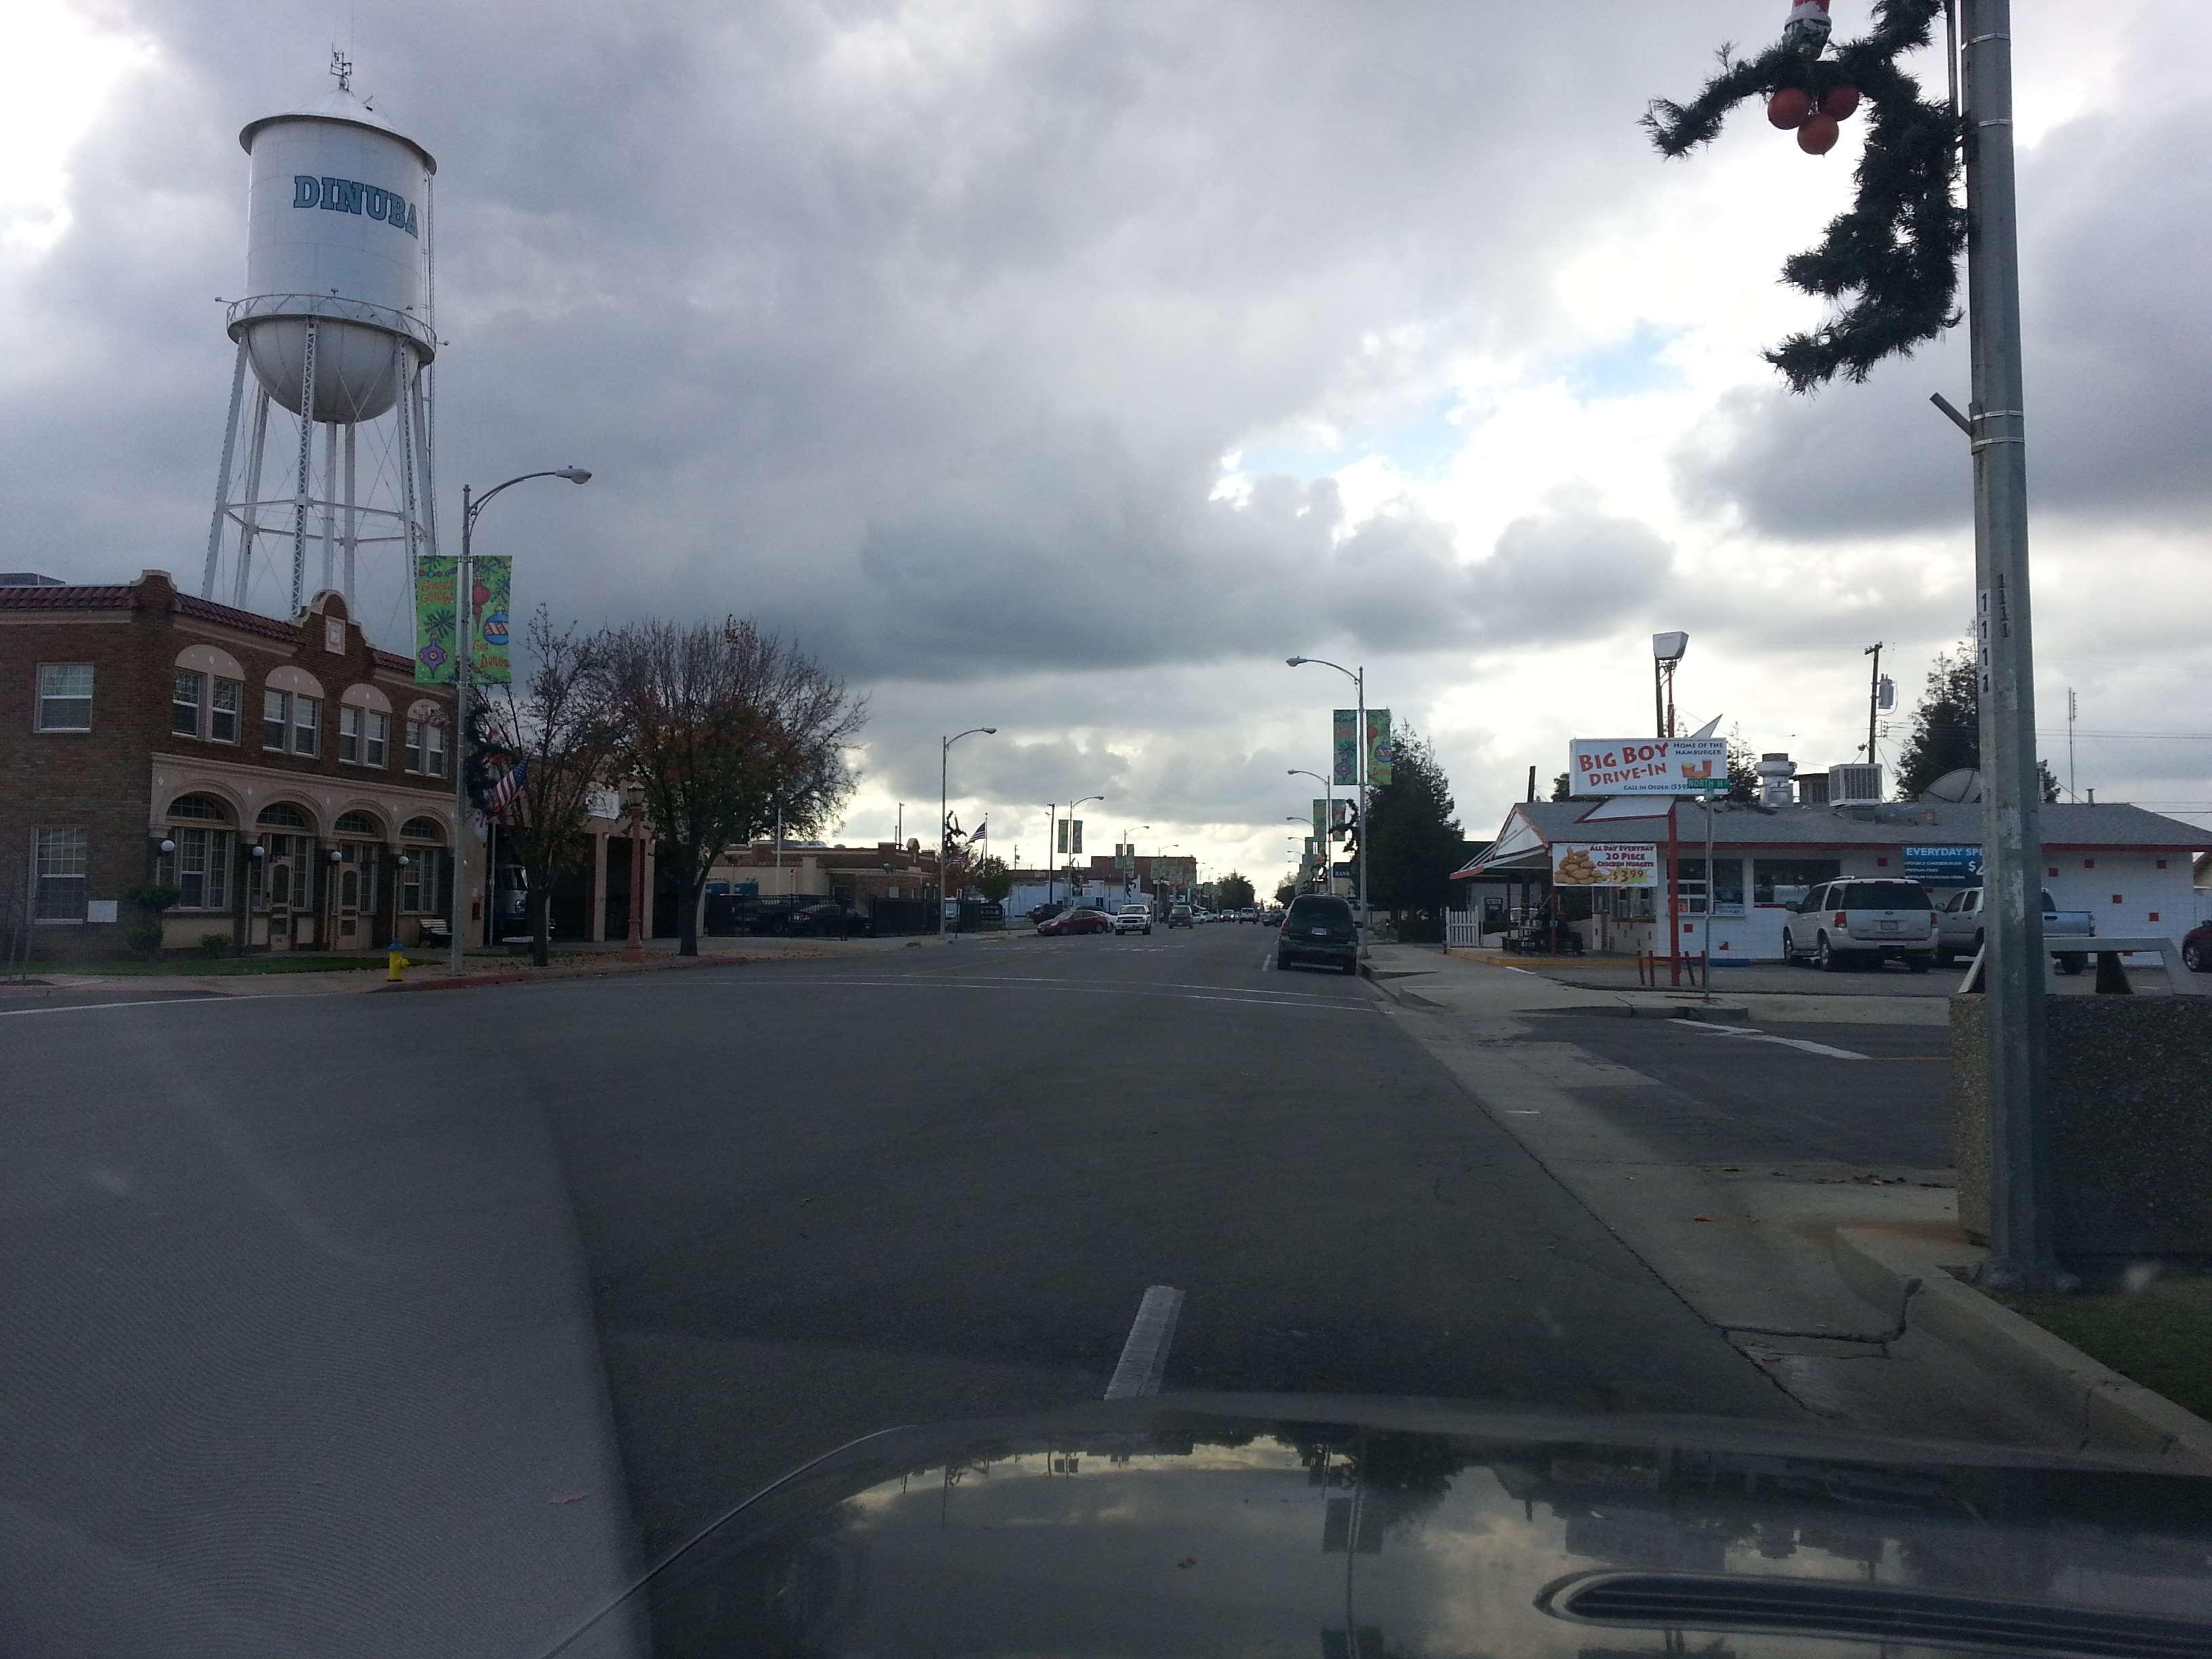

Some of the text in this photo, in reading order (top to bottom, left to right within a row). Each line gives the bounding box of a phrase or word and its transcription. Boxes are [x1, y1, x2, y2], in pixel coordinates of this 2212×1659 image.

[293, 176, 418, 239] DINUBA
[1579, 742, 1669, 772] BIG BOY
[1589, 762, 1667, 787] DRIVE-IN
[1687, 779, 1714, 788] NORTH
[1605, 853, 1645, 861] 20 PIECE
[1906, 848, 1963, 856] EVERYDAY
